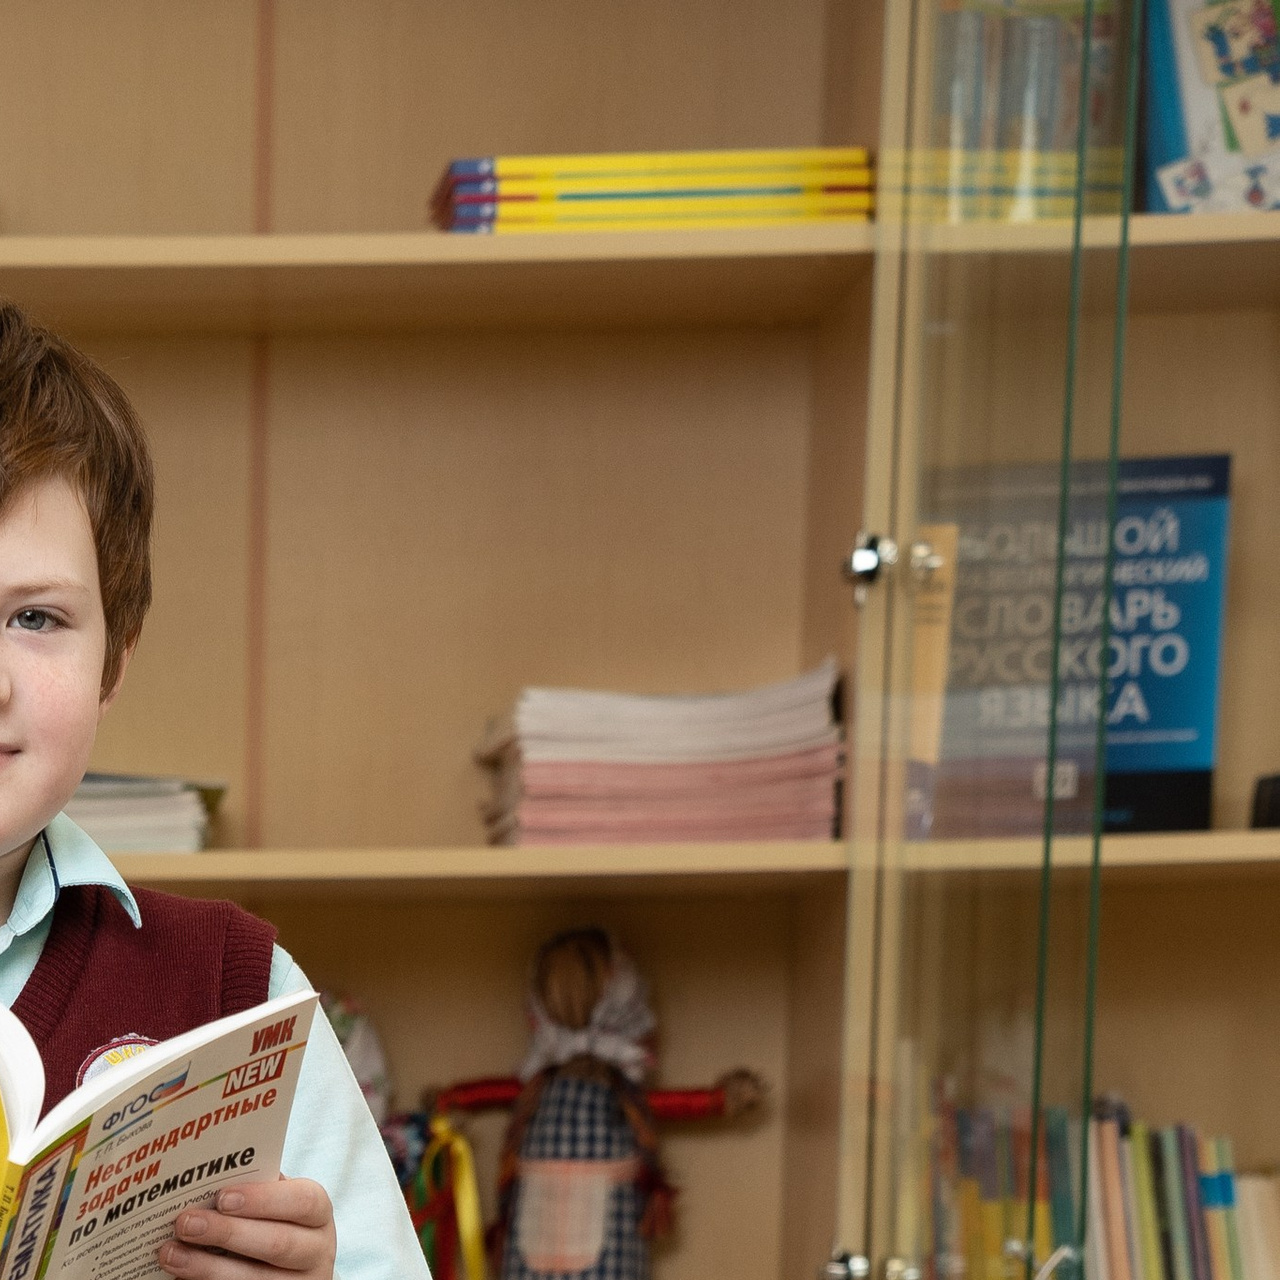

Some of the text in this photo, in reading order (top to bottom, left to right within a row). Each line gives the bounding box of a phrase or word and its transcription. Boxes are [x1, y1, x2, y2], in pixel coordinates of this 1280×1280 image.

[956, 587, 1181, 636] СЛОВАРЬ
[978, 681, 1150, 728] ЯЗЫКА
[249, 1015, 297, 1056] УМК
[224, 1052, 282, 1095] NEW
[102, 1082, 166, 1131] ФГОС
[84, 1088, 277, 1195] Нестандартные
[116, 1119, 153, 1148] Быкова
[68, 1147, 255, 1247] по математике
[75, 1159, 162, 1221] задачи
[76, 1239, 103, 1261] всем
[102, 1202, 182, 1248] действующим
[182, 1187, 221, 1210] учебн
[99, 1243, 144, 1270] Творческий
